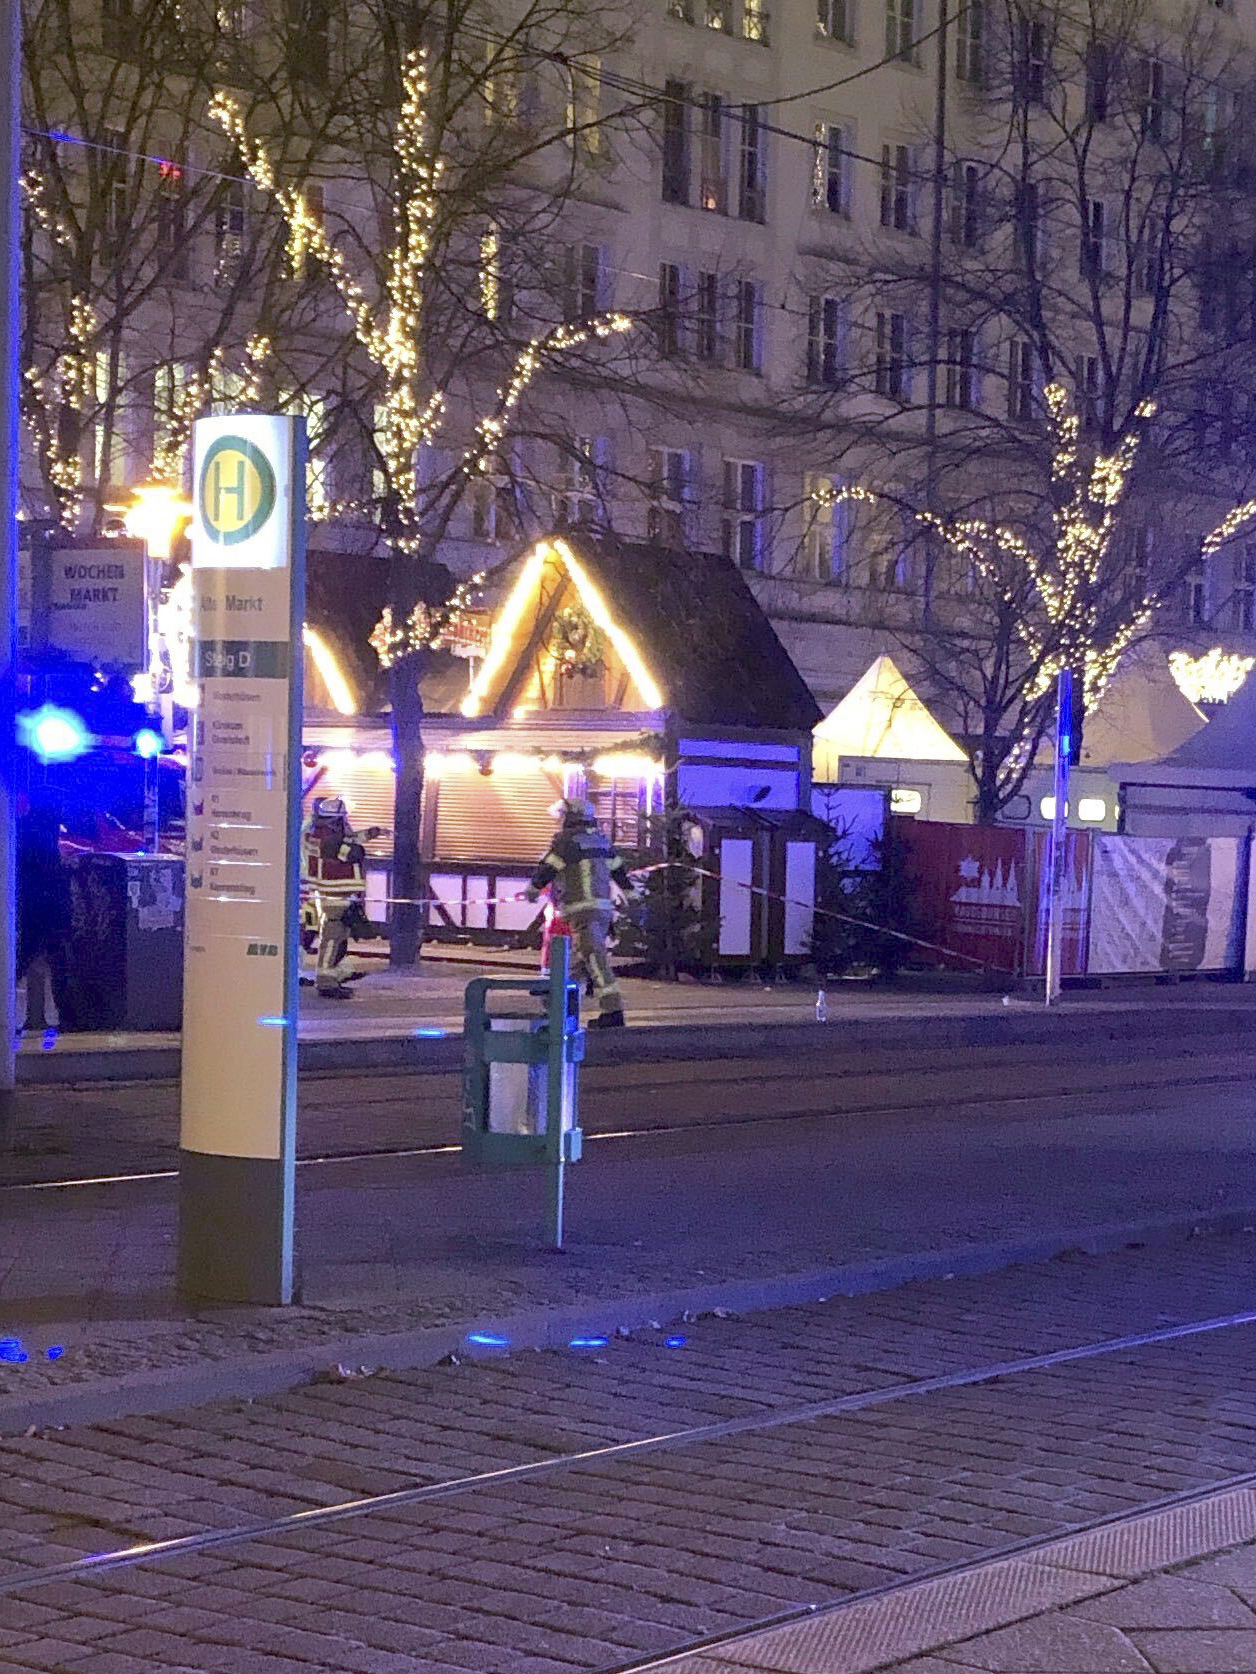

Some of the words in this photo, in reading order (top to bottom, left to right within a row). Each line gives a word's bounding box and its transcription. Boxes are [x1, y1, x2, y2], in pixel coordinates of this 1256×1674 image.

[70, 587, 119, 602] MARKT
[225, 594, 263, 612] Markt
[239, 651, 251, 667] D
